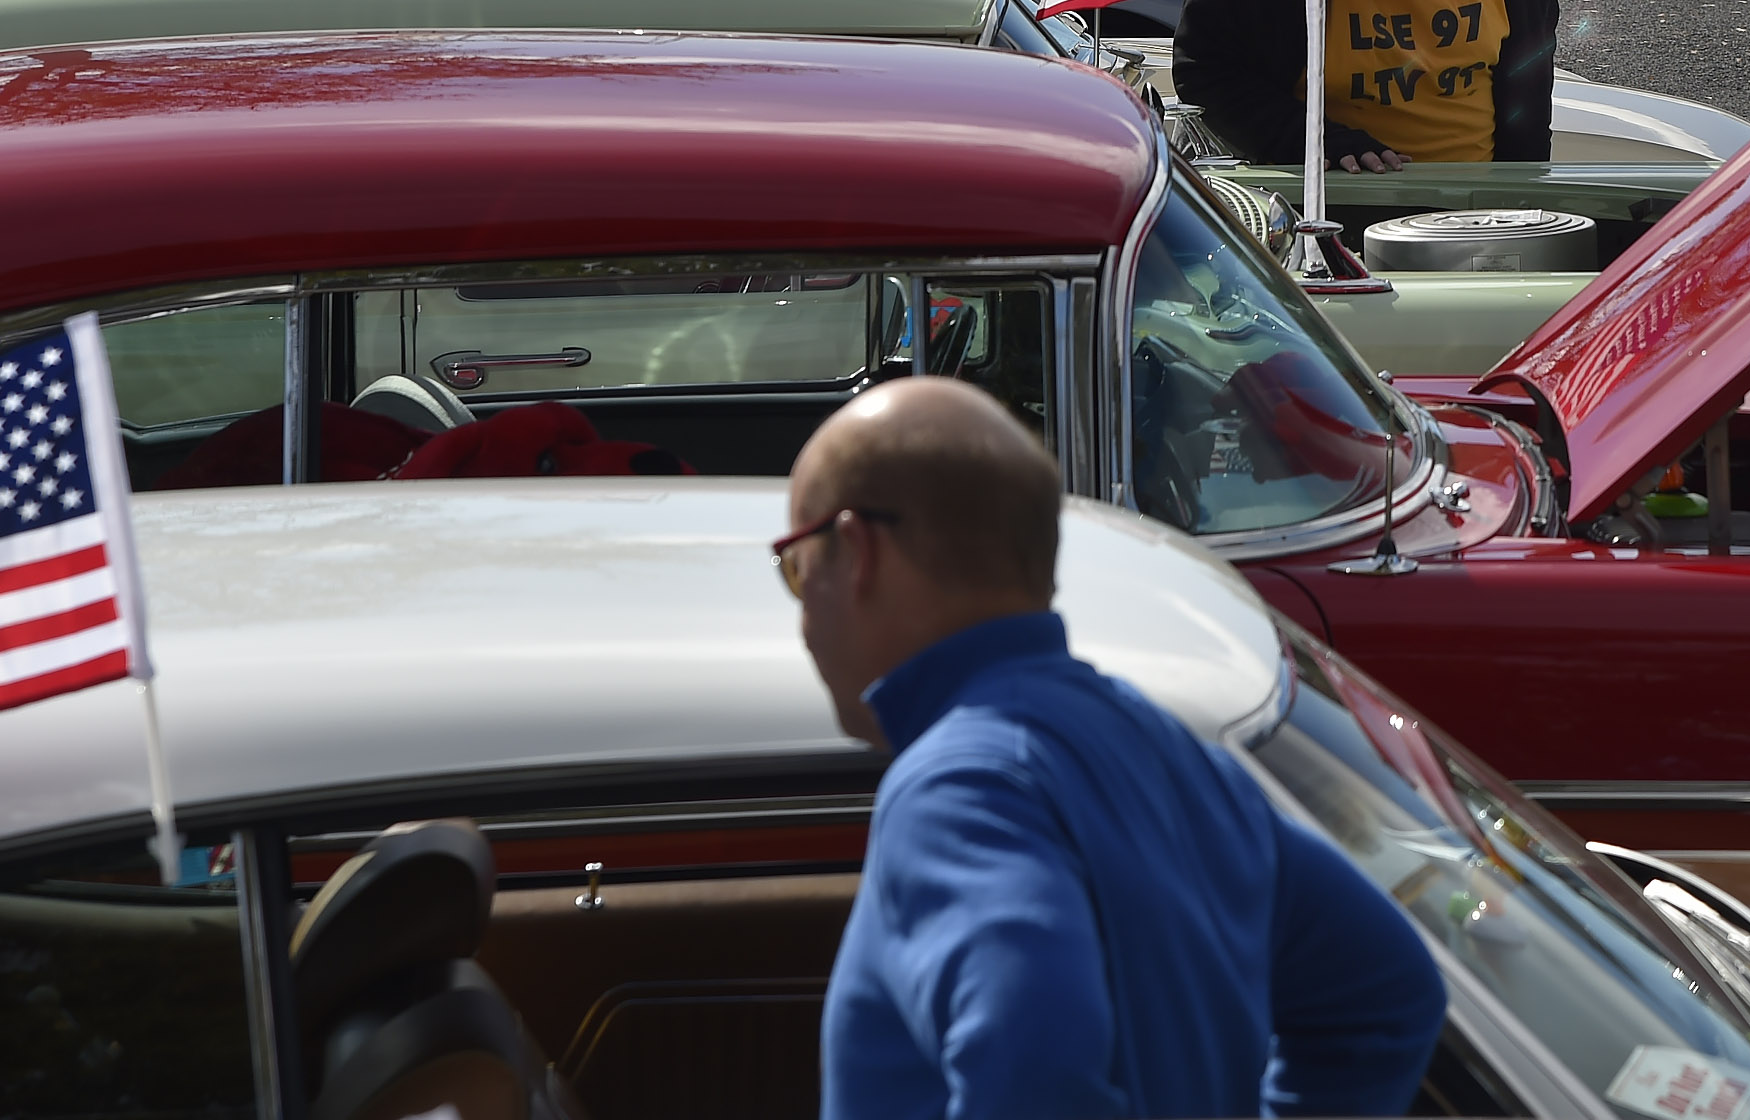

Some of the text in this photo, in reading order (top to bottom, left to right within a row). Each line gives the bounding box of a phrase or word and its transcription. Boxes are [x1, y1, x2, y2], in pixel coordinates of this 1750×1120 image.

[1349, 2, 1482, 50] LSE 97
[1351, 67, 1425, 105] LTV
